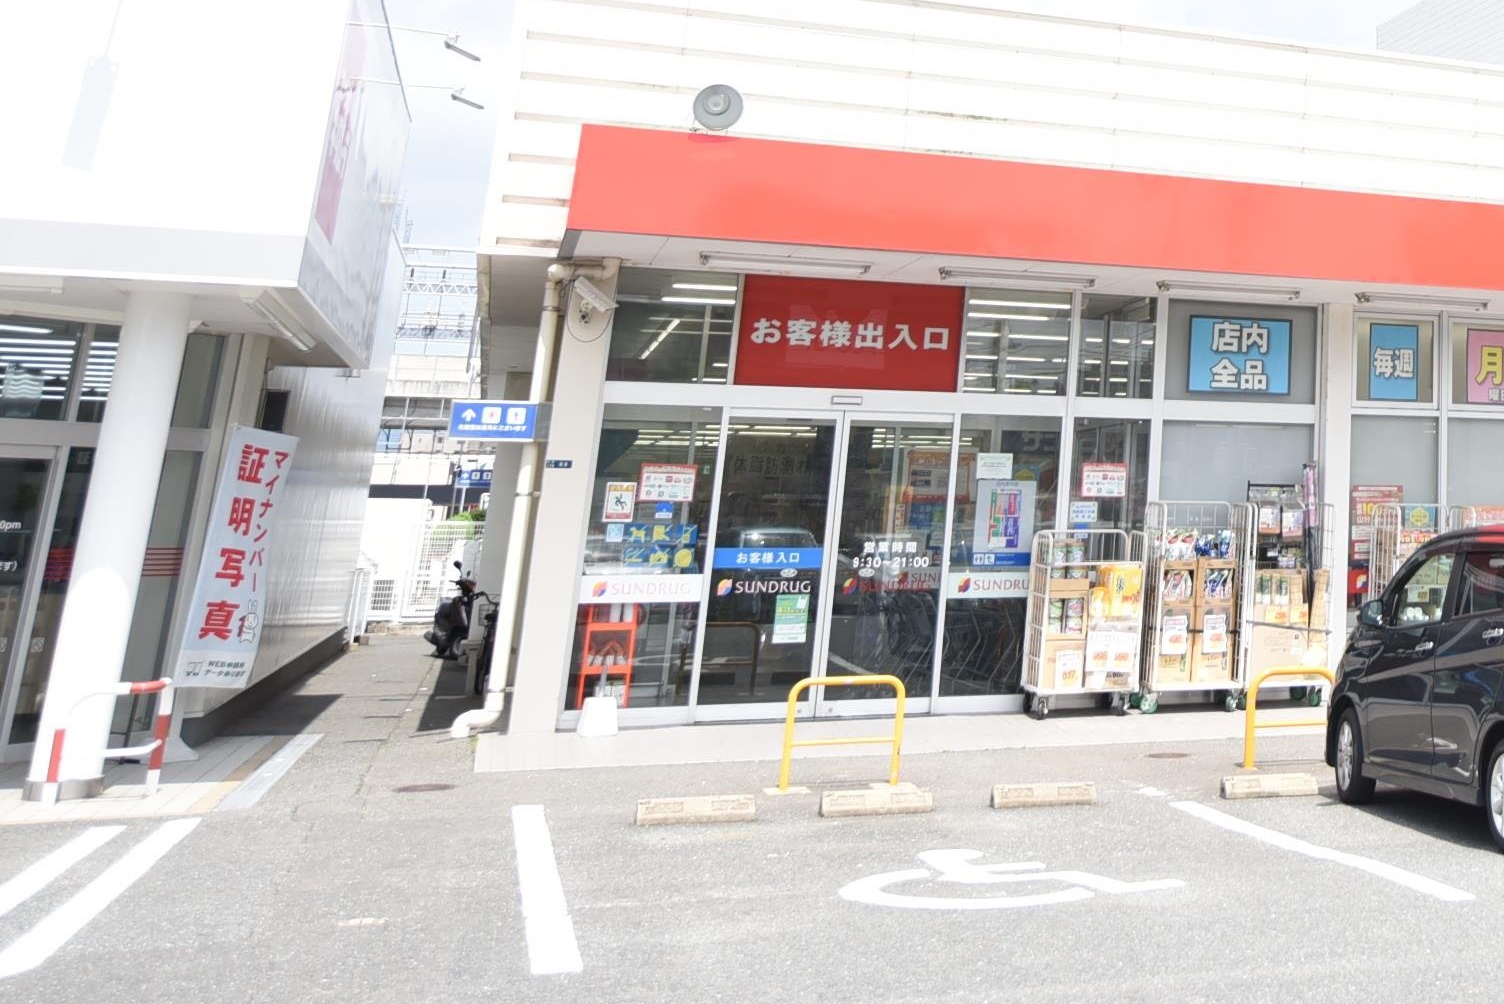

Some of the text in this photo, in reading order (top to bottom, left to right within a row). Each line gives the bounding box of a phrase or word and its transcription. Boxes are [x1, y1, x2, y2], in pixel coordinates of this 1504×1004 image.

[751, 317, 950, 350] お客様出入口
[1211, 322, 1269, 354] 店内
[1209, 358, 1268, 391] 全品
[1373, 347, 1415, 380] 毎週
[249, 451, 289, 592] マイナンバー
[200, 444, 269, 641] 証明写真
[736, 552, 800, 563] お客様入口
[864, 542, 917, 553] 営業時間
[611, 581, 690, 596] SUNDRUG
[735, 580, 812, 593] SUNDRUG
[973, 579, 1029, 591] SUNDRU
